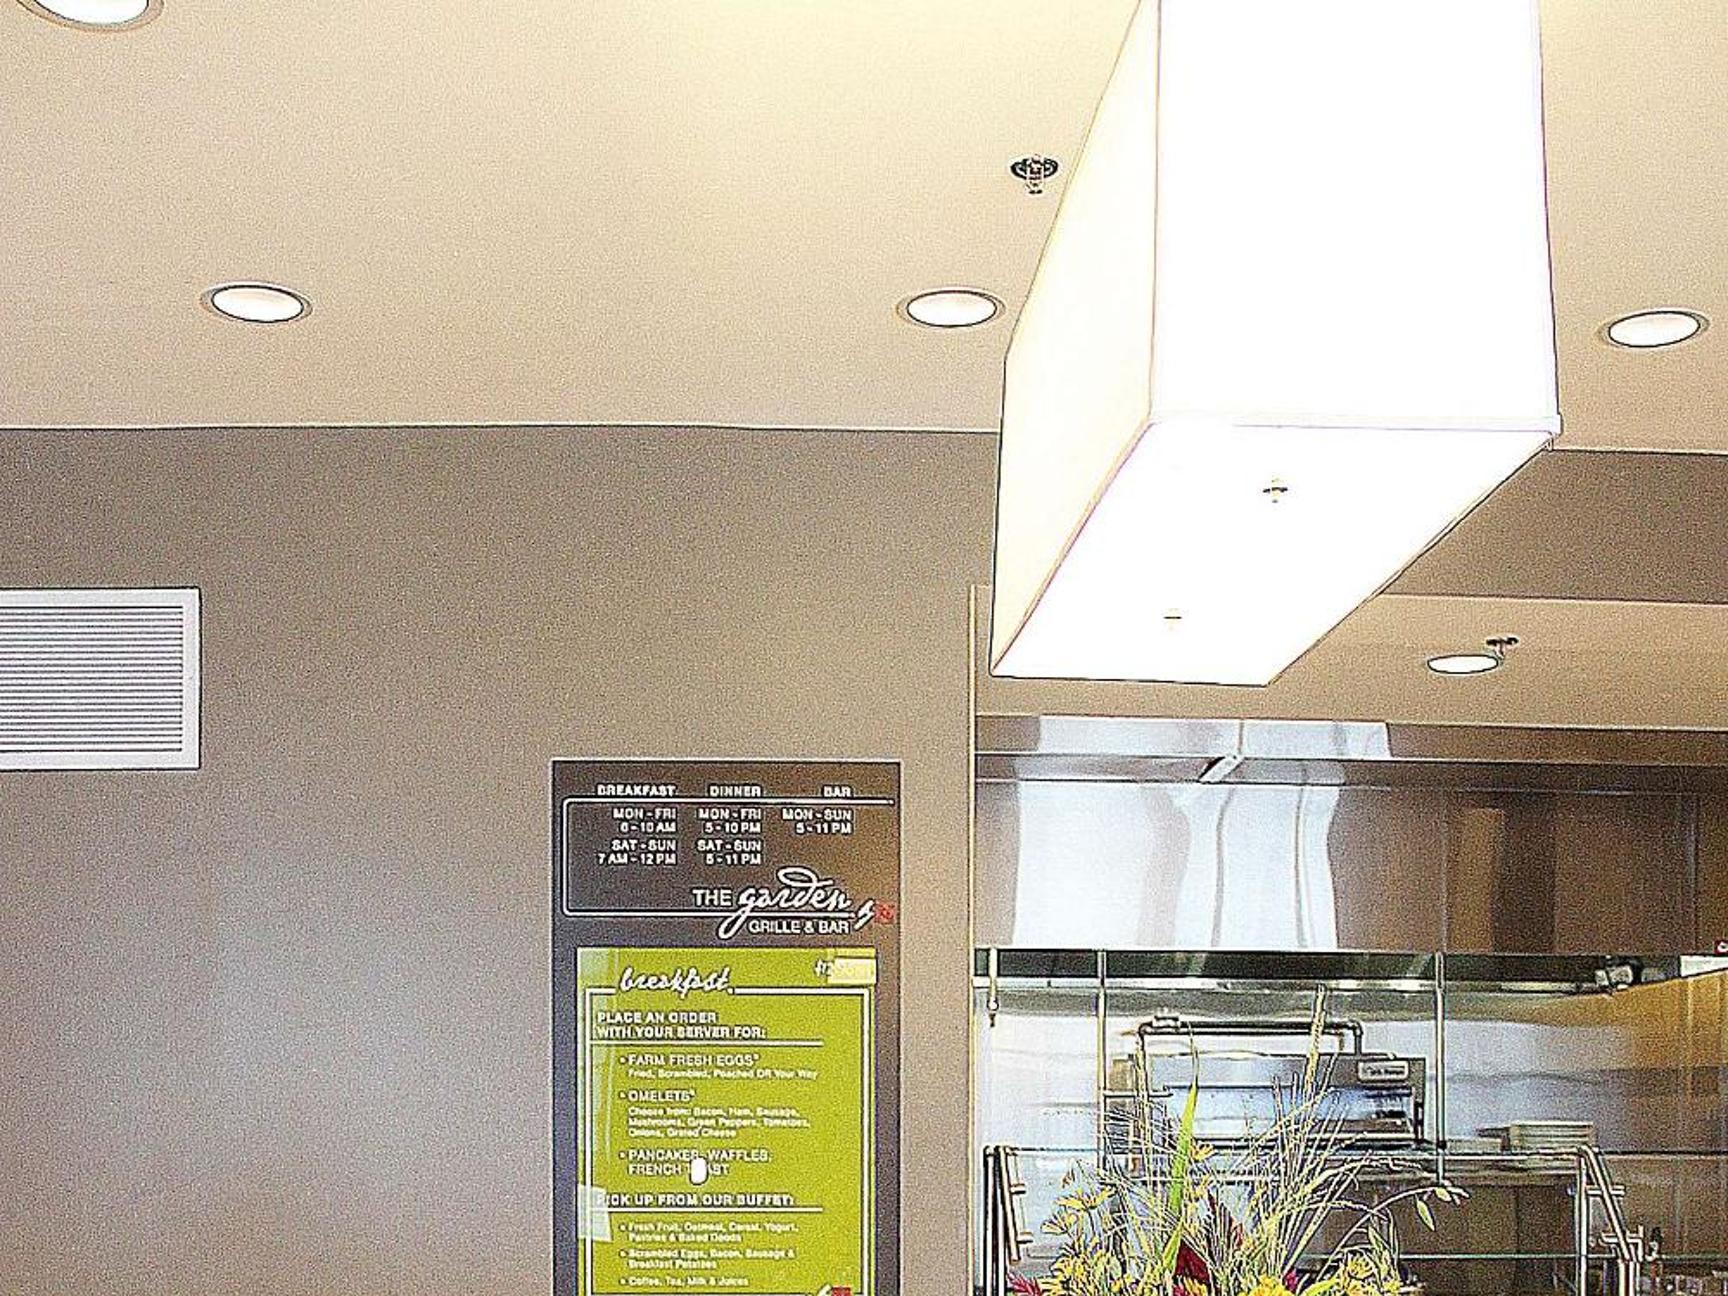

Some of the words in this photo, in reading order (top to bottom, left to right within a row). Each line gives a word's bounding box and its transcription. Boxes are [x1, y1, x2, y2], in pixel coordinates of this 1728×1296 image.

[597, 785, 677, 797] BREAKFAST
[709, 785, 762, 797] DINNER
[823, 785, 851, 797] BAR
[612, 808, 644, 820] MON
[654, 808, 676, 820] FRI
[699, 808, 730, 820] MON
[740, 808, 762, 820] FRI
[782, 808, 813, 820] MON
[823, 808, 851, 820] SUN
[640, 822, 654, 833] 10
[656, 822, 676, 833] AM
[704, 822, 714, 833] 5
[724, 822, 739, 833] 10
[741, 822, 762, 833] PM
[796, 822, 805, 834] 5
[816, 822, 829, 834] 11
[831, 822, 852, 834] PM
[611, 839, 638, 851] SAT
[648, 839, 676, 851] SUN
[697, 839, 724, 851] SAT
[733, 839, 762, 851] SUN
[598, 853, 606, 864] 7
[608, 853, 628, 864] AM
[640, 853, 654, 864] 12
[656, 853, 676, 864] PM
[705, 853, 714, 865] 5
[725, 853, 739, 865] 11
[741, 853, 762, 865] PM
[692, 889, 732, 906] THE
[717, 867, 853, 939] garden
[749, 920, 801, 934] GRILLE
[803, 920, 814, 934] &
[818, 920, 850, 934] BAR
[619, 965, 731, 999] breakfast
[597, 1011, 642, 1024] PLACE
[646, 1011, 665, 1024] AN
[668, 1011, 717, 1024] ORDER
[596, 1026, 632, 1039] WITH
[635, 1026, 674, 1039] YOUR
[677, 1026, 730, 1039] SERVER
[628, 1054, 666, 1066] FARM
[670, 1054, 713, 1066] FRESH
[628, 1163, 682, 1176] FRENCH
[685, 1163, 730, 1176] TAST
[635, 1194, 653, 1206] UP
[657, 1194, 699, 1206] FROM
[702, 1194, 733, 1206] OUR
